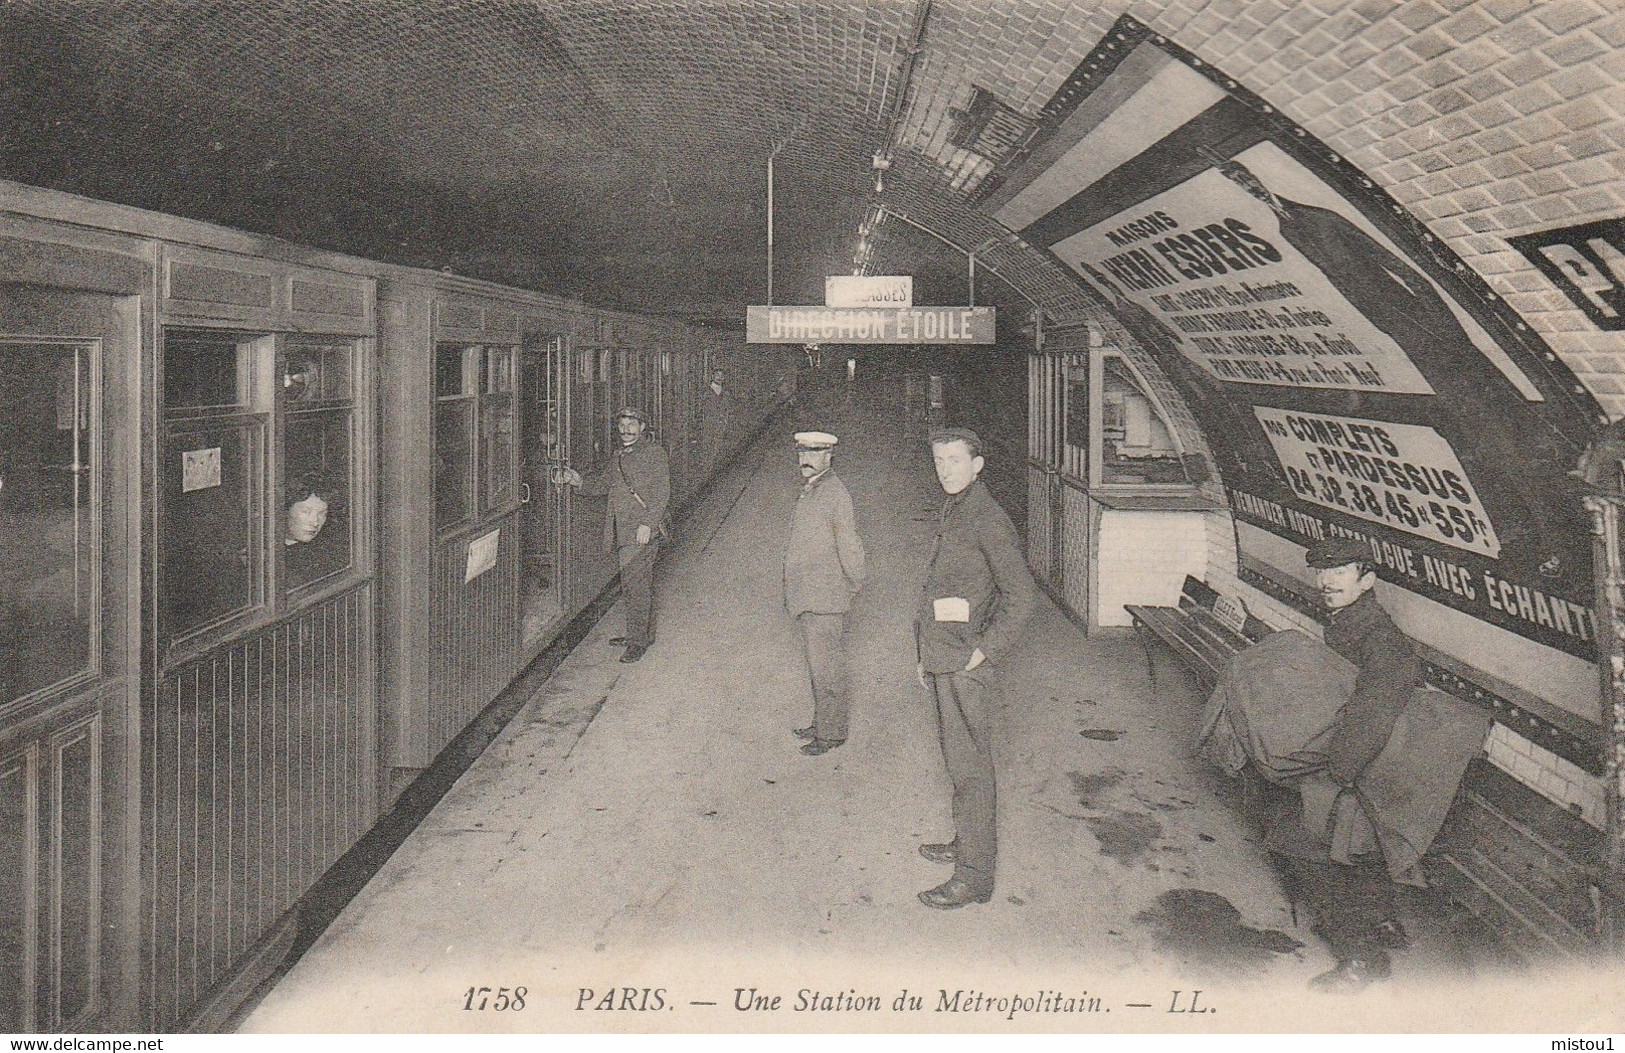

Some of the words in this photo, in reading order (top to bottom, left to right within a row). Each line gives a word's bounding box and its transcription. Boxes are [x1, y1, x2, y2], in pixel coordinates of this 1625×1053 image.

[1100, 247, 1180, 292] HENRI
[1151, 217, 1282, 281] ESDERS
[1105, 211, 1178, 248] MAISONS
[768, 310, 886, 339] DIRECTION
[896, 306, 974, 340] ÉTOILE
[1286, 415, 1399, 458] COMPLETS
[1318, 447, 1471, 504] PARDESSUS
[1286, 507, 1326, 541] NOTRE
[1422, 554, 1476, 601] AVEC
